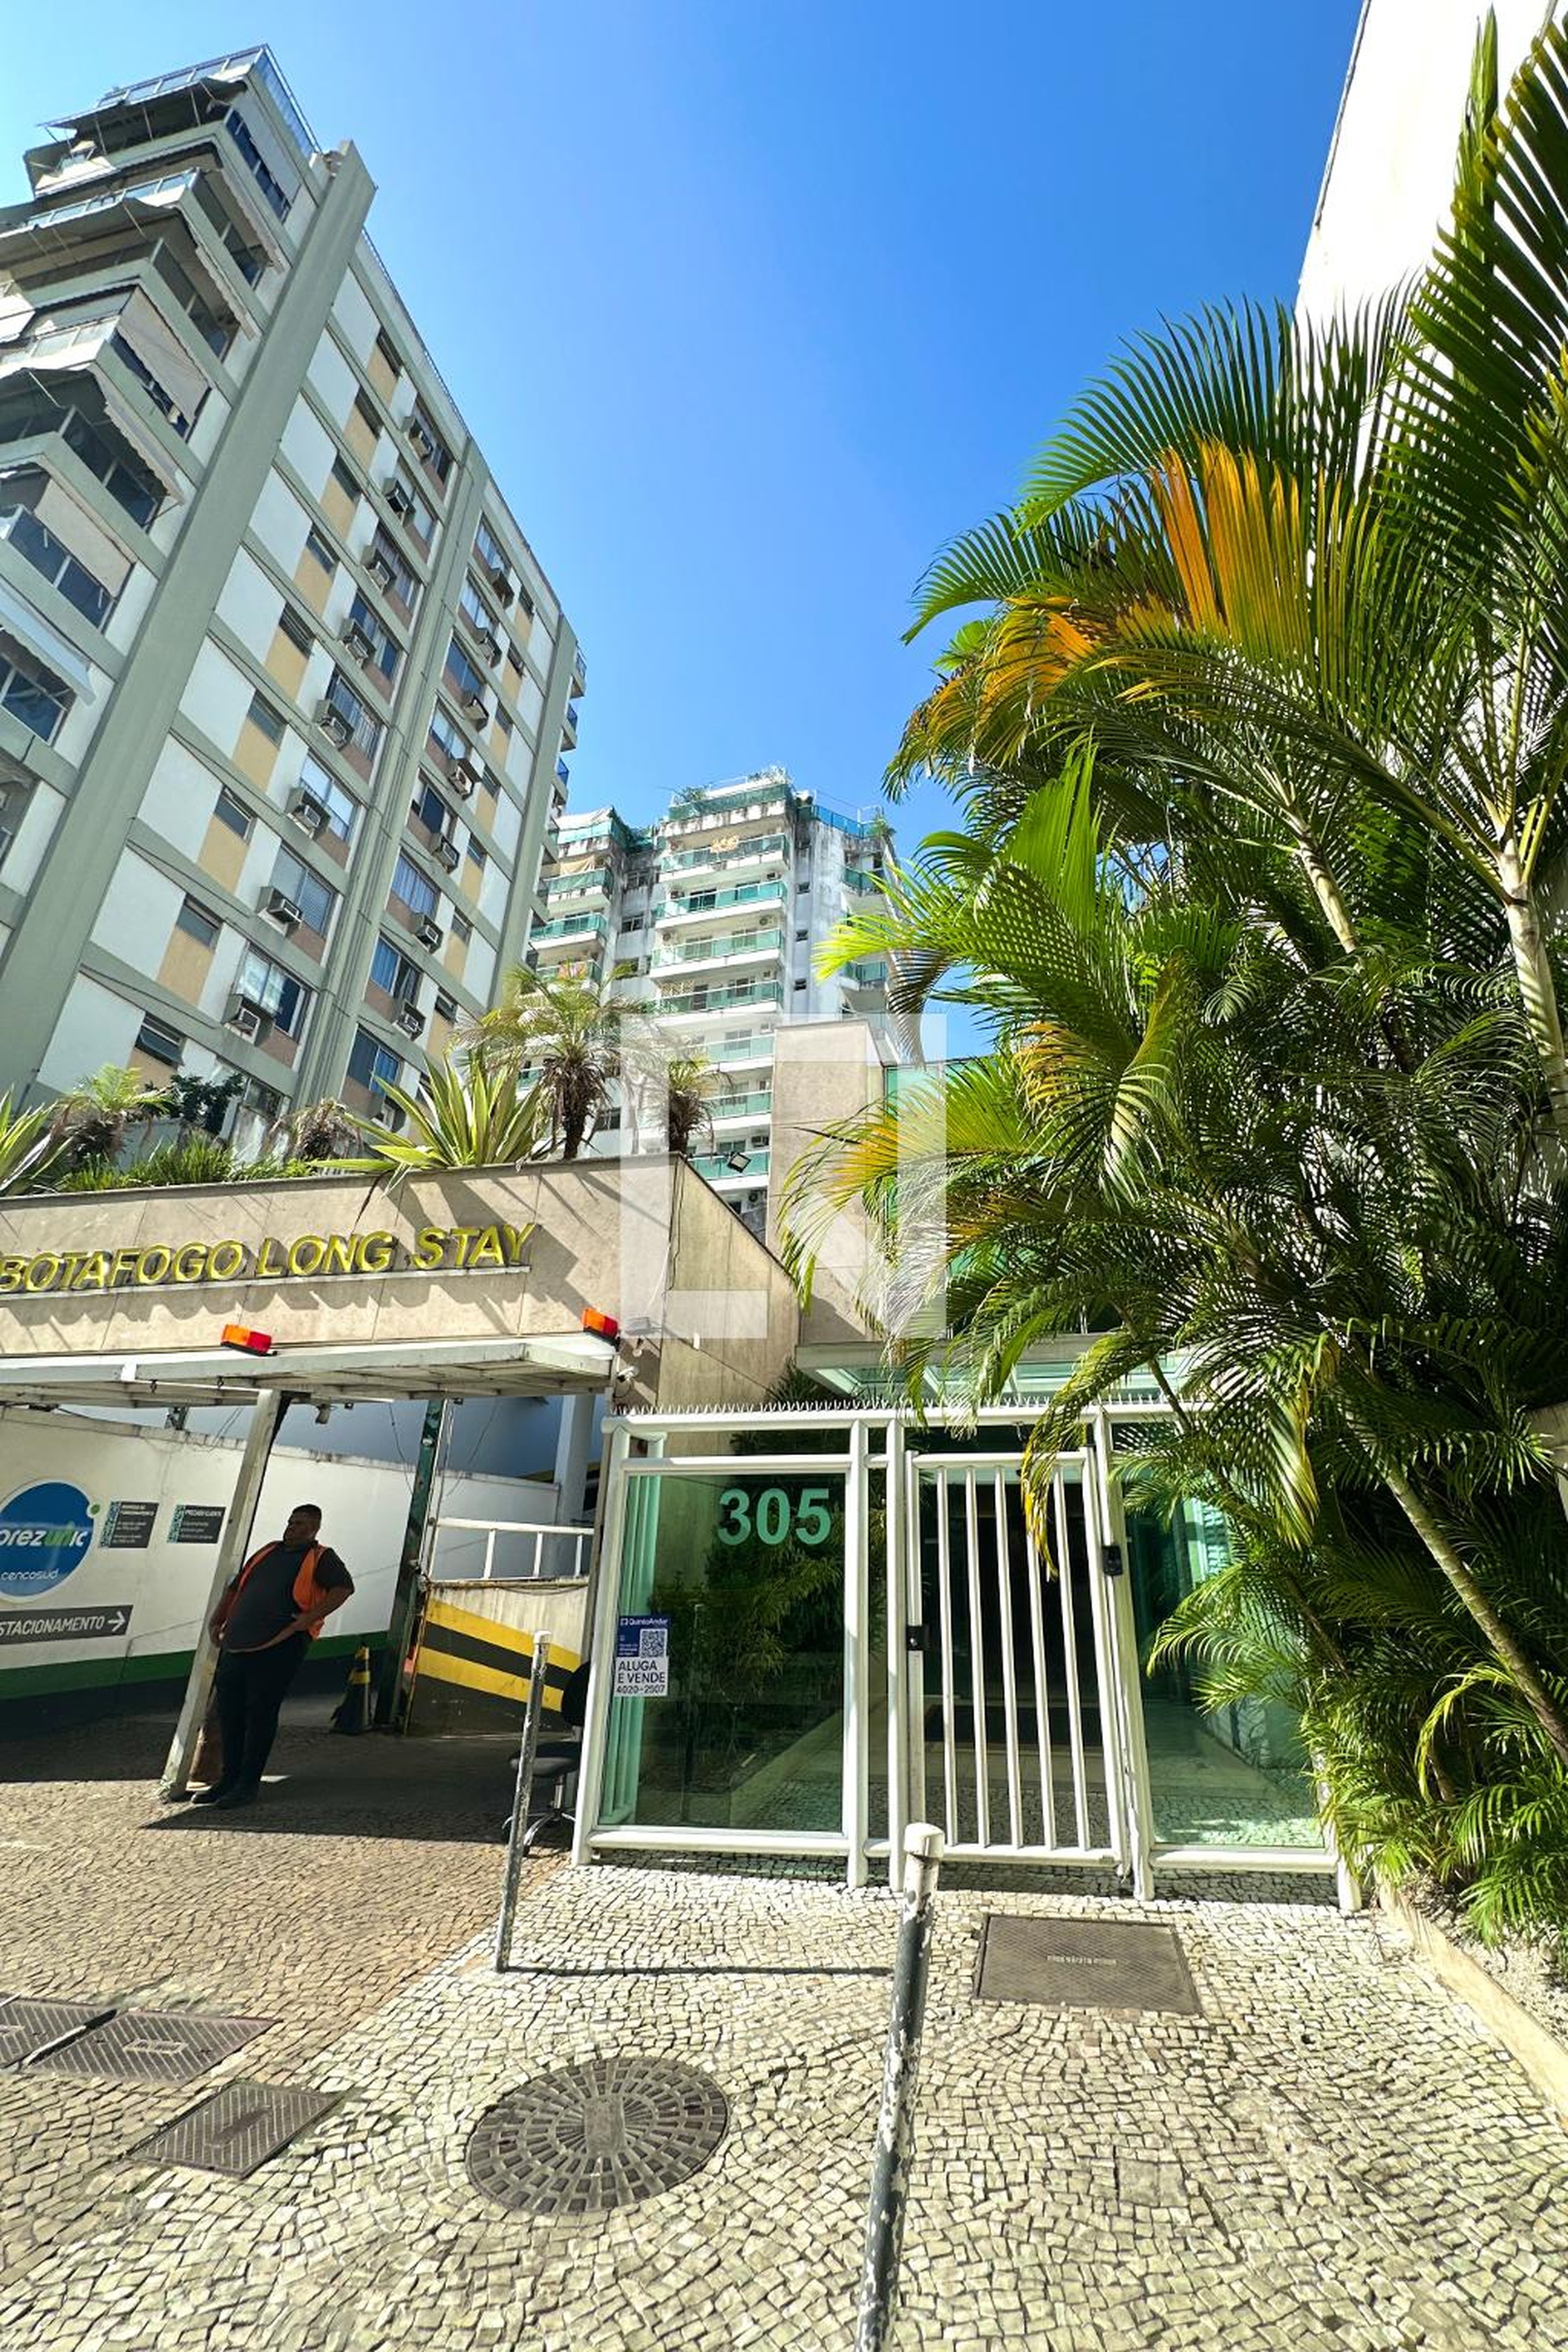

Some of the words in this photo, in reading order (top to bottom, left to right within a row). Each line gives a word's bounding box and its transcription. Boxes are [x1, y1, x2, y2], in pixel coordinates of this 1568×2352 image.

[0, 1240, 246, 1292] BOTAFOGO
[256, 1231, 394, 1277] LONG
[412, 1223, 535, 1270] STAY
[717, 1488, 832, 1545] 305
[1, 1568, 59, 1581] cencosud
[618, 1660, 657, 1671] ALUGA
[618, 1673, 624, 1684] E
[627, 1672, 665, 1684] VENDE
